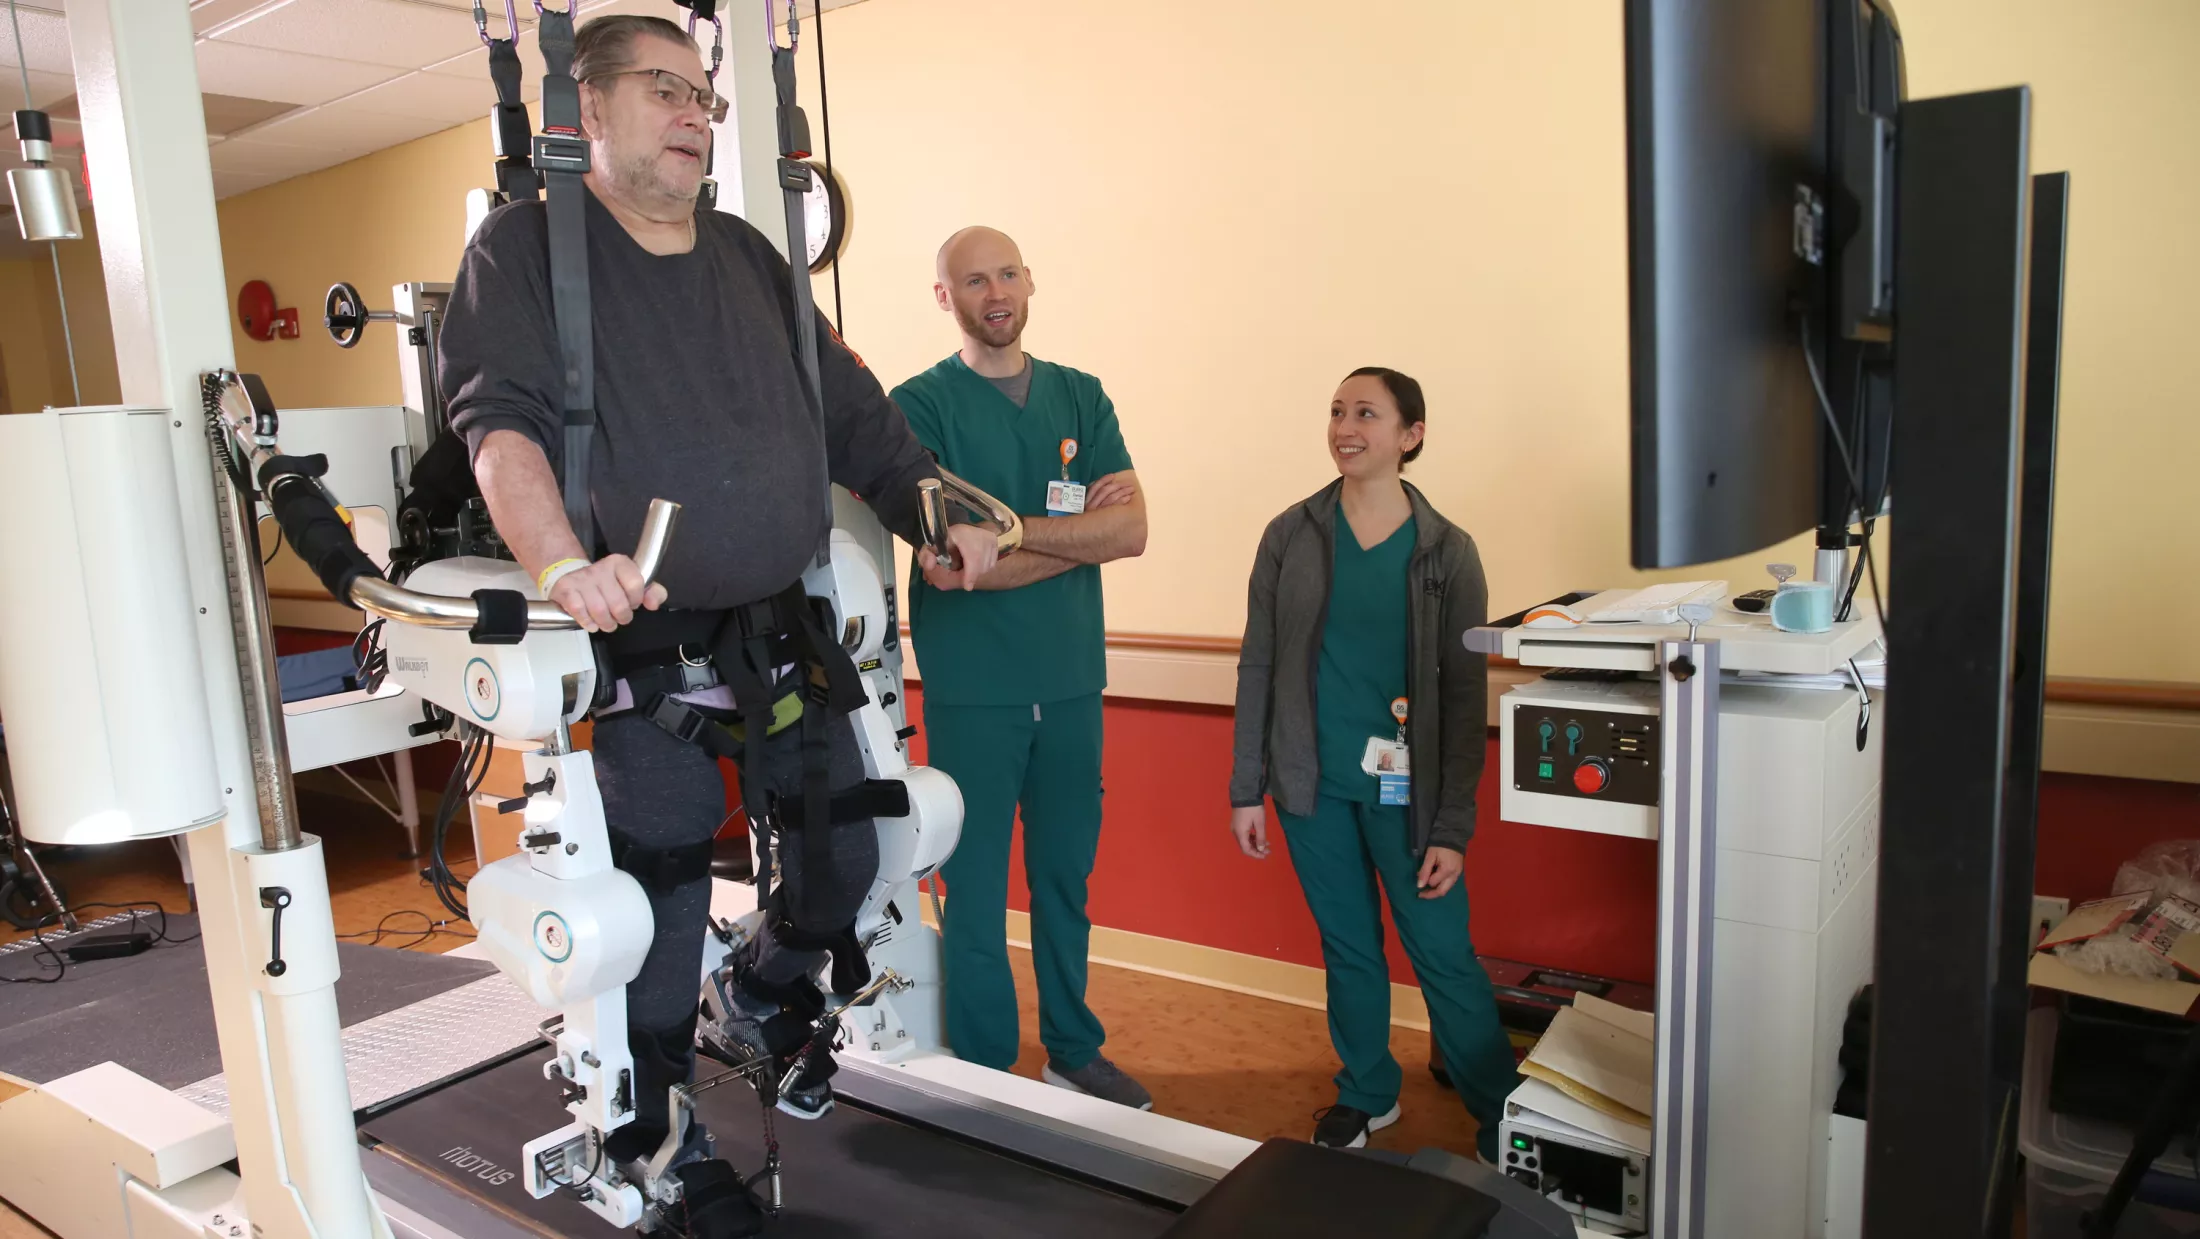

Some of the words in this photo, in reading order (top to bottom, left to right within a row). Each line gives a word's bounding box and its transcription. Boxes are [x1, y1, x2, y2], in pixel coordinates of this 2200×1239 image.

[816, 185, 822, 199] 2
[824, 205, 828, 218] 3
[821, 228, 826, 239] 4
[809, 245, 816, 258] 5
